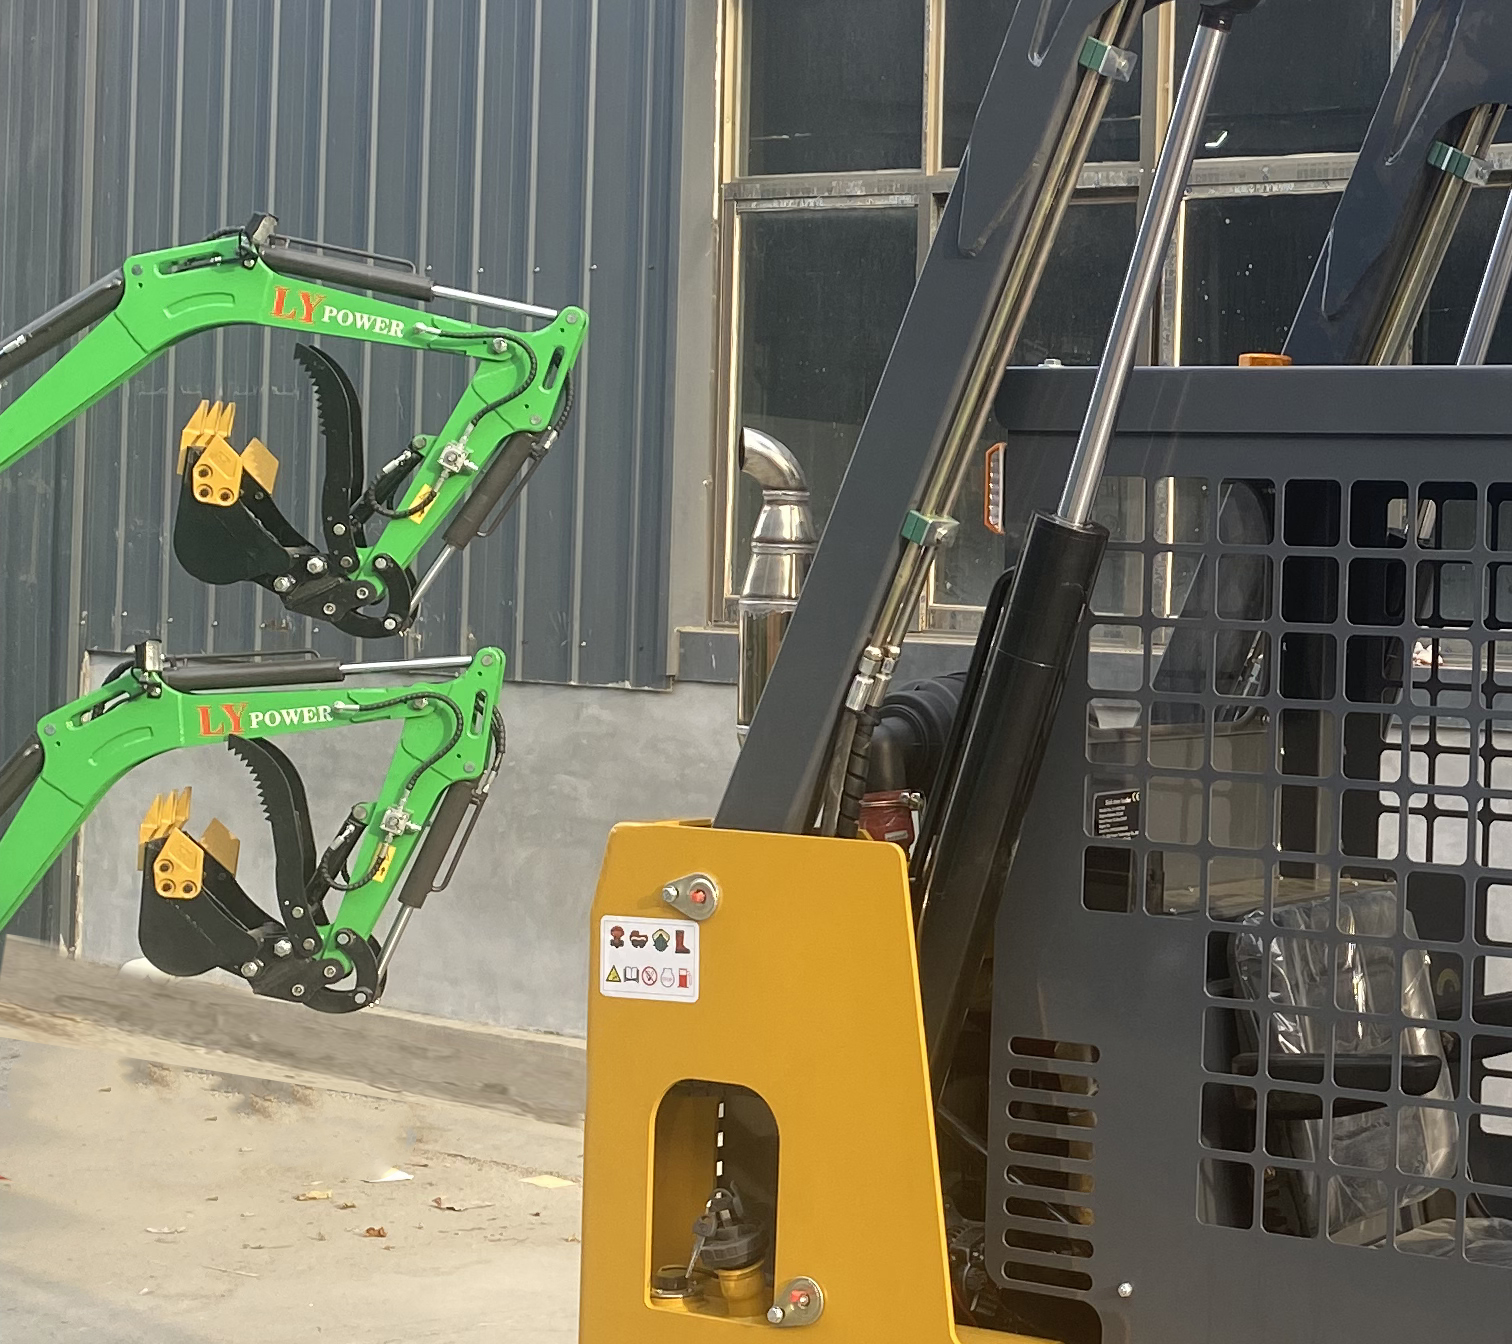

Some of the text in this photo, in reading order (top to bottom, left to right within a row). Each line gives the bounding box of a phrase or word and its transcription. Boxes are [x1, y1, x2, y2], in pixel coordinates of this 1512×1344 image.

[270, 285, 405, 338] LY POWER
[196, 702, 333, 736] LY POWER
